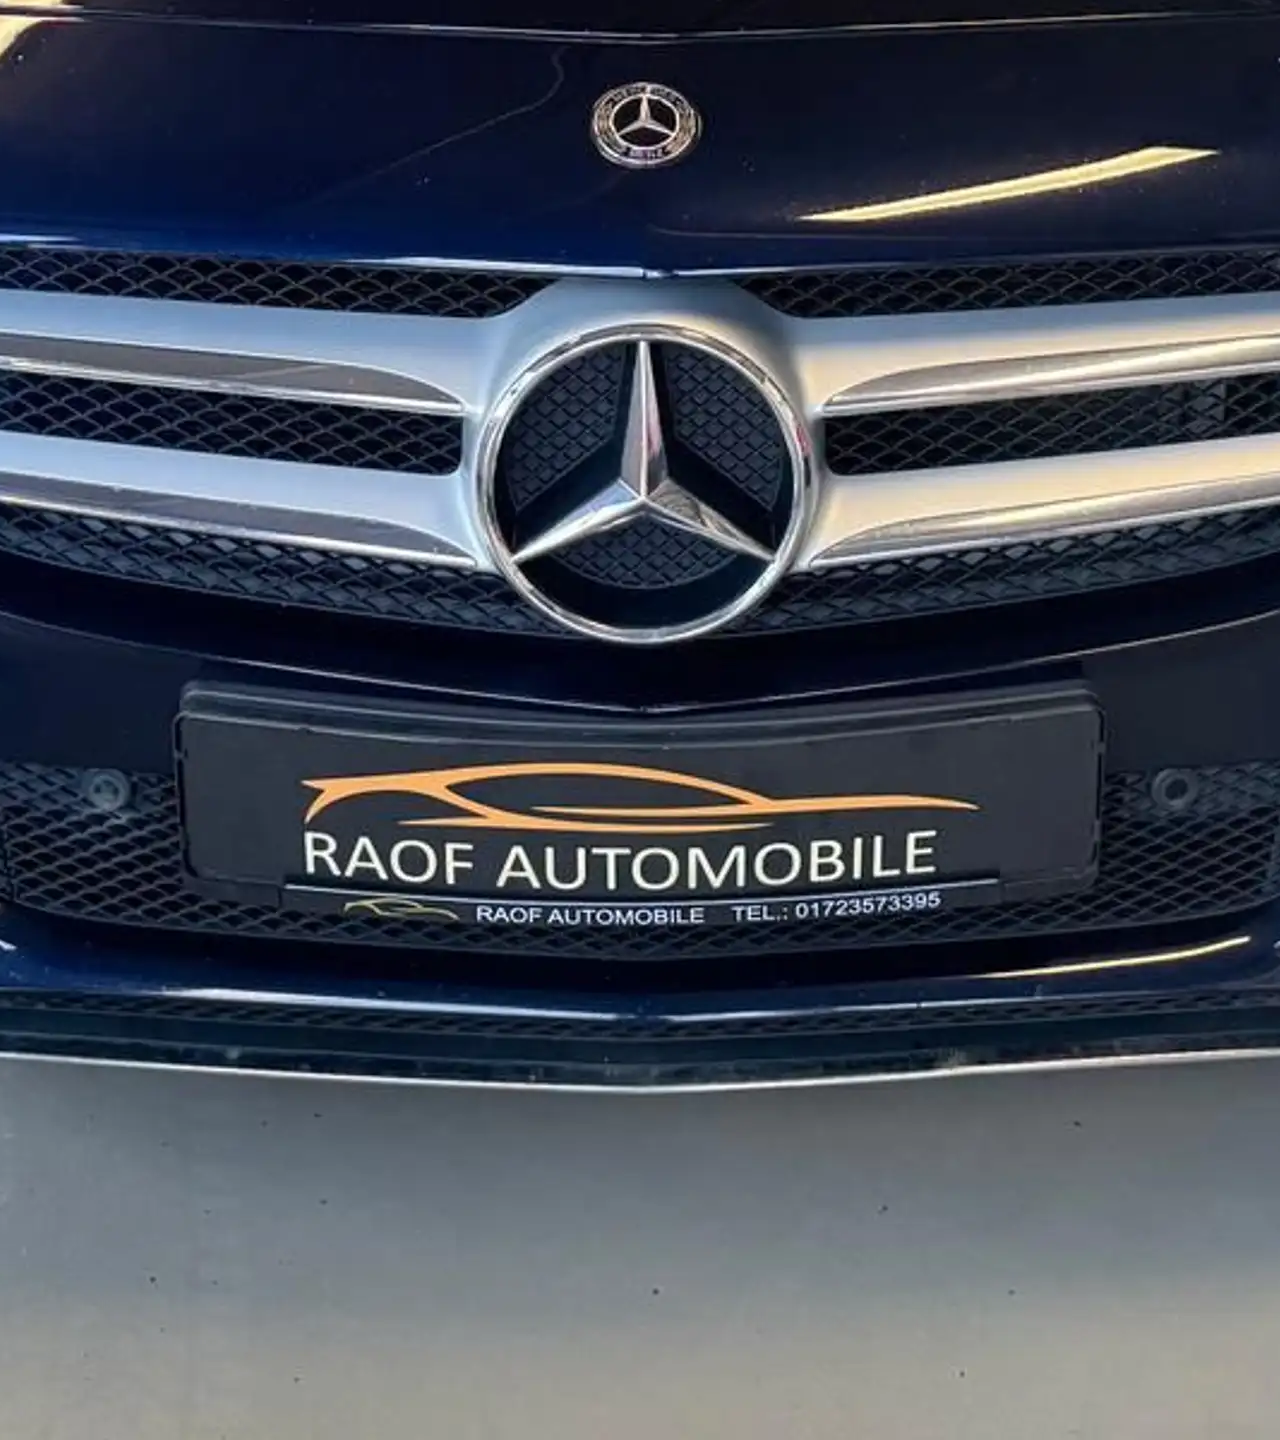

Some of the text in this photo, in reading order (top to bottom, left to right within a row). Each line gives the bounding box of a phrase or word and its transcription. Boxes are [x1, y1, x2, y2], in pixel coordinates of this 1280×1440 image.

[303, 829, 938, 891] RAOF AUTOMOBILE
[475, 891, 942, 927] RAOF AUTOMOBILE TEL.: 01723573395
